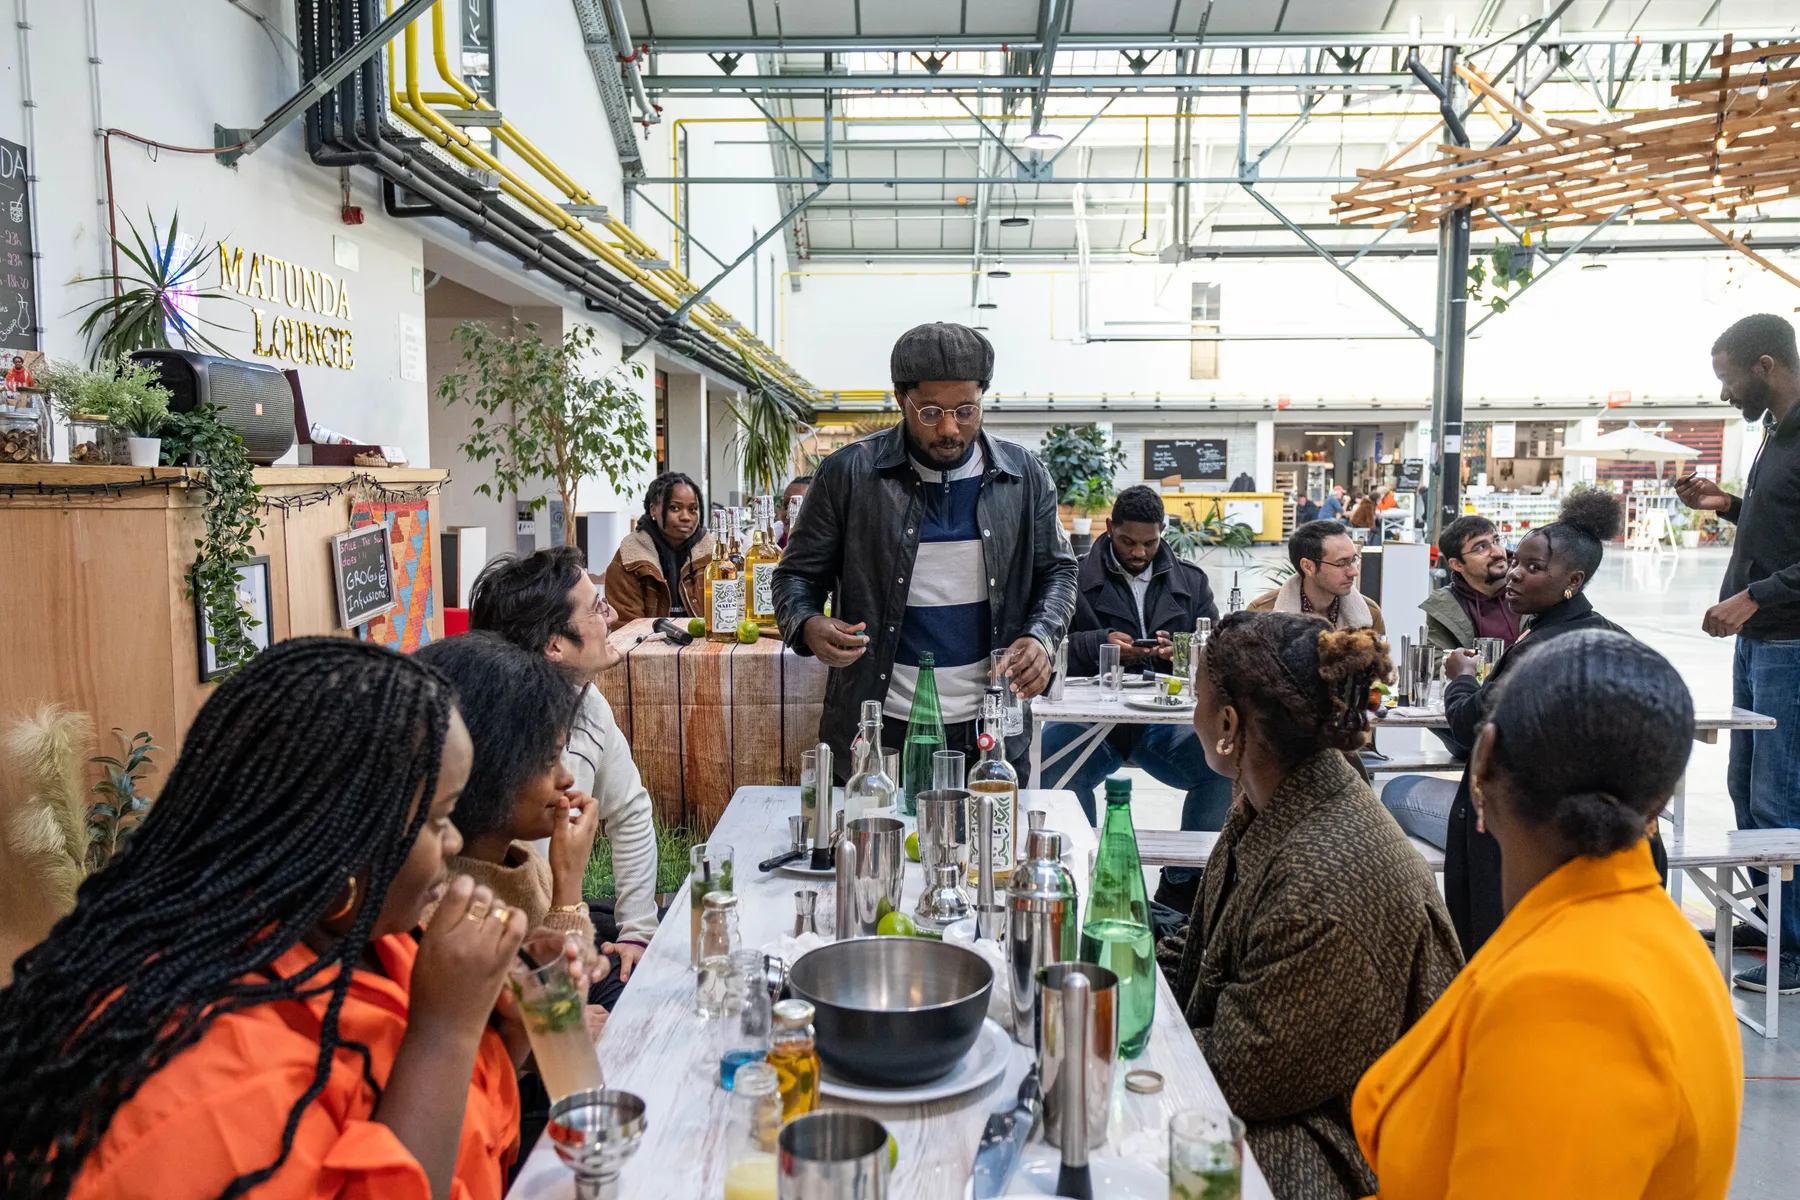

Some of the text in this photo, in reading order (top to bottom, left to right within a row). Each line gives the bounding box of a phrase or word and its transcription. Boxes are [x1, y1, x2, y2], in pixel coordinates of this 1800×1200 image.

[1, 145, 27, 182] DA
[217, 240, 353, 321] MATUNDA
[251, 308, 355, 370] LOUNGE
